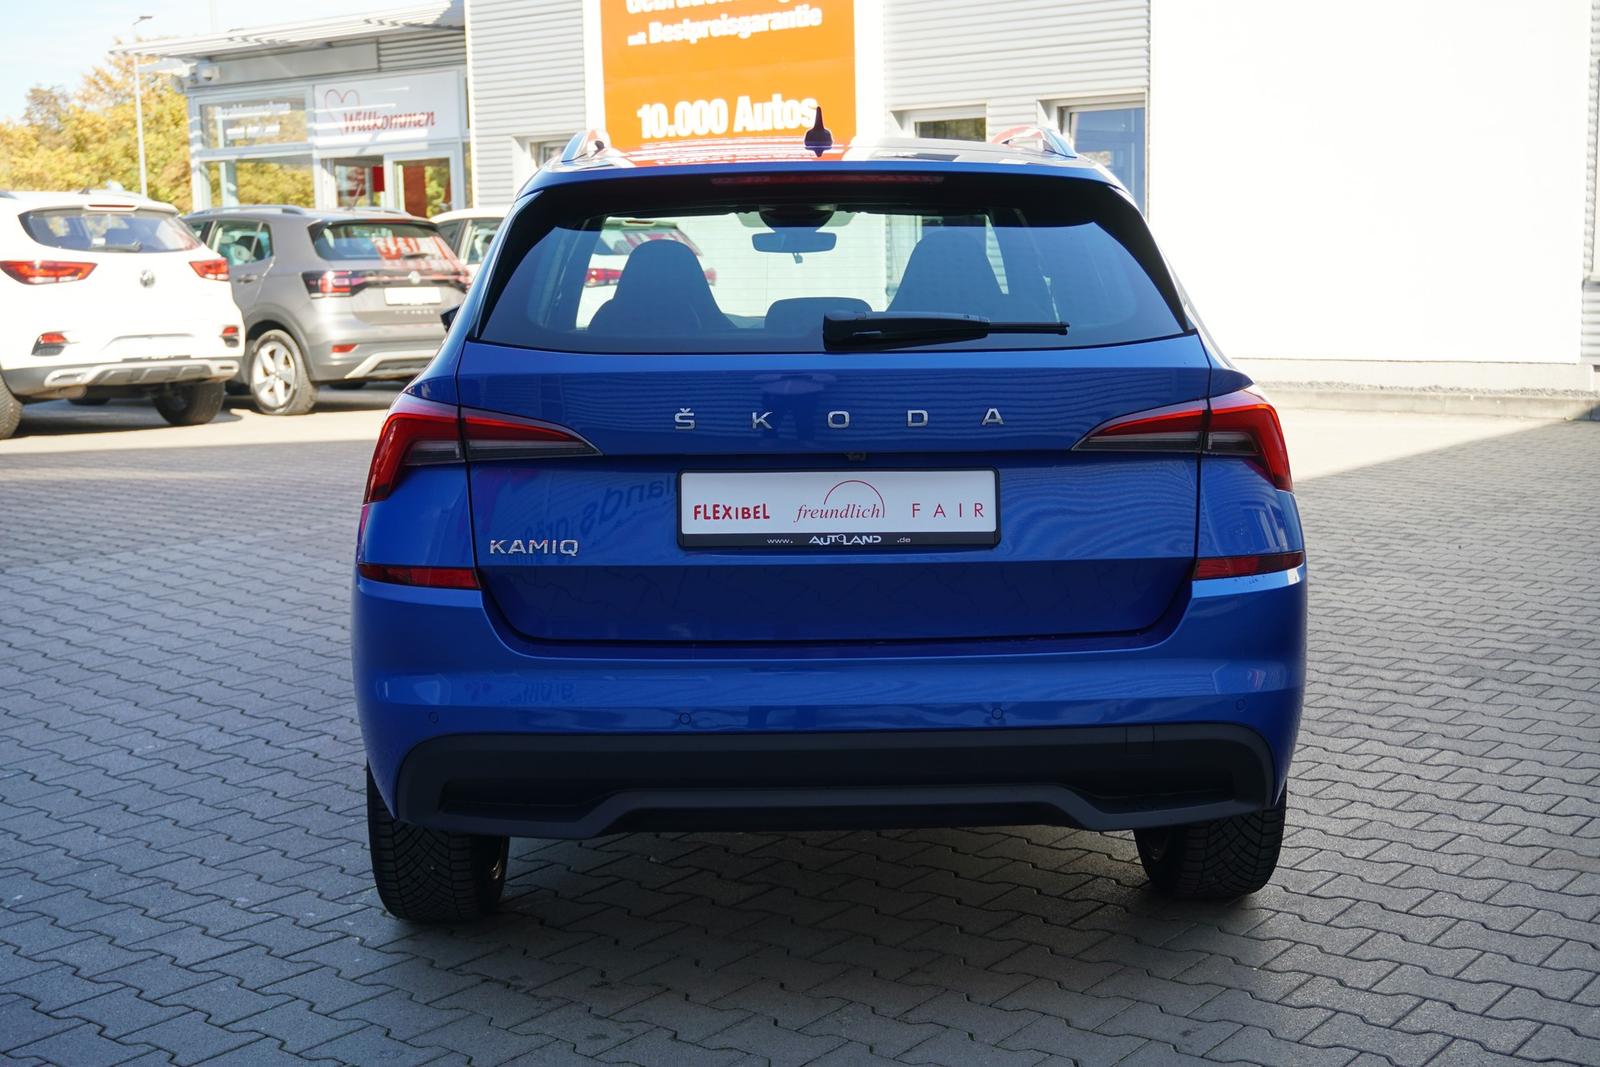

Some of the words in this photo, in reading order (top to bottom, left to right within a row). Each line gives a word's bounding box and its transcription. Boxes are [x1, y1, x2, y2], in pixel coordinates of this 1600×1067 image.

[649, 4, 822, 44] Bestpreisgarantie
[343, 111, 436, 133] Willkommen
[637, 98, 728, 138] 10.000
[733, 93, 818, 132] Autos
[674, 408, 1004, 430] ŠKODA
[693, 503, 770, 520] FLEXIBEL
[793, 503, 880, 523] freundlich
[911, 502, 984, 518] FAIR
[489, 539, 579, 557] KAMIQ
[765, 537, 794, 545] www.
[808, 533, 882, 546] AUTOLAND
